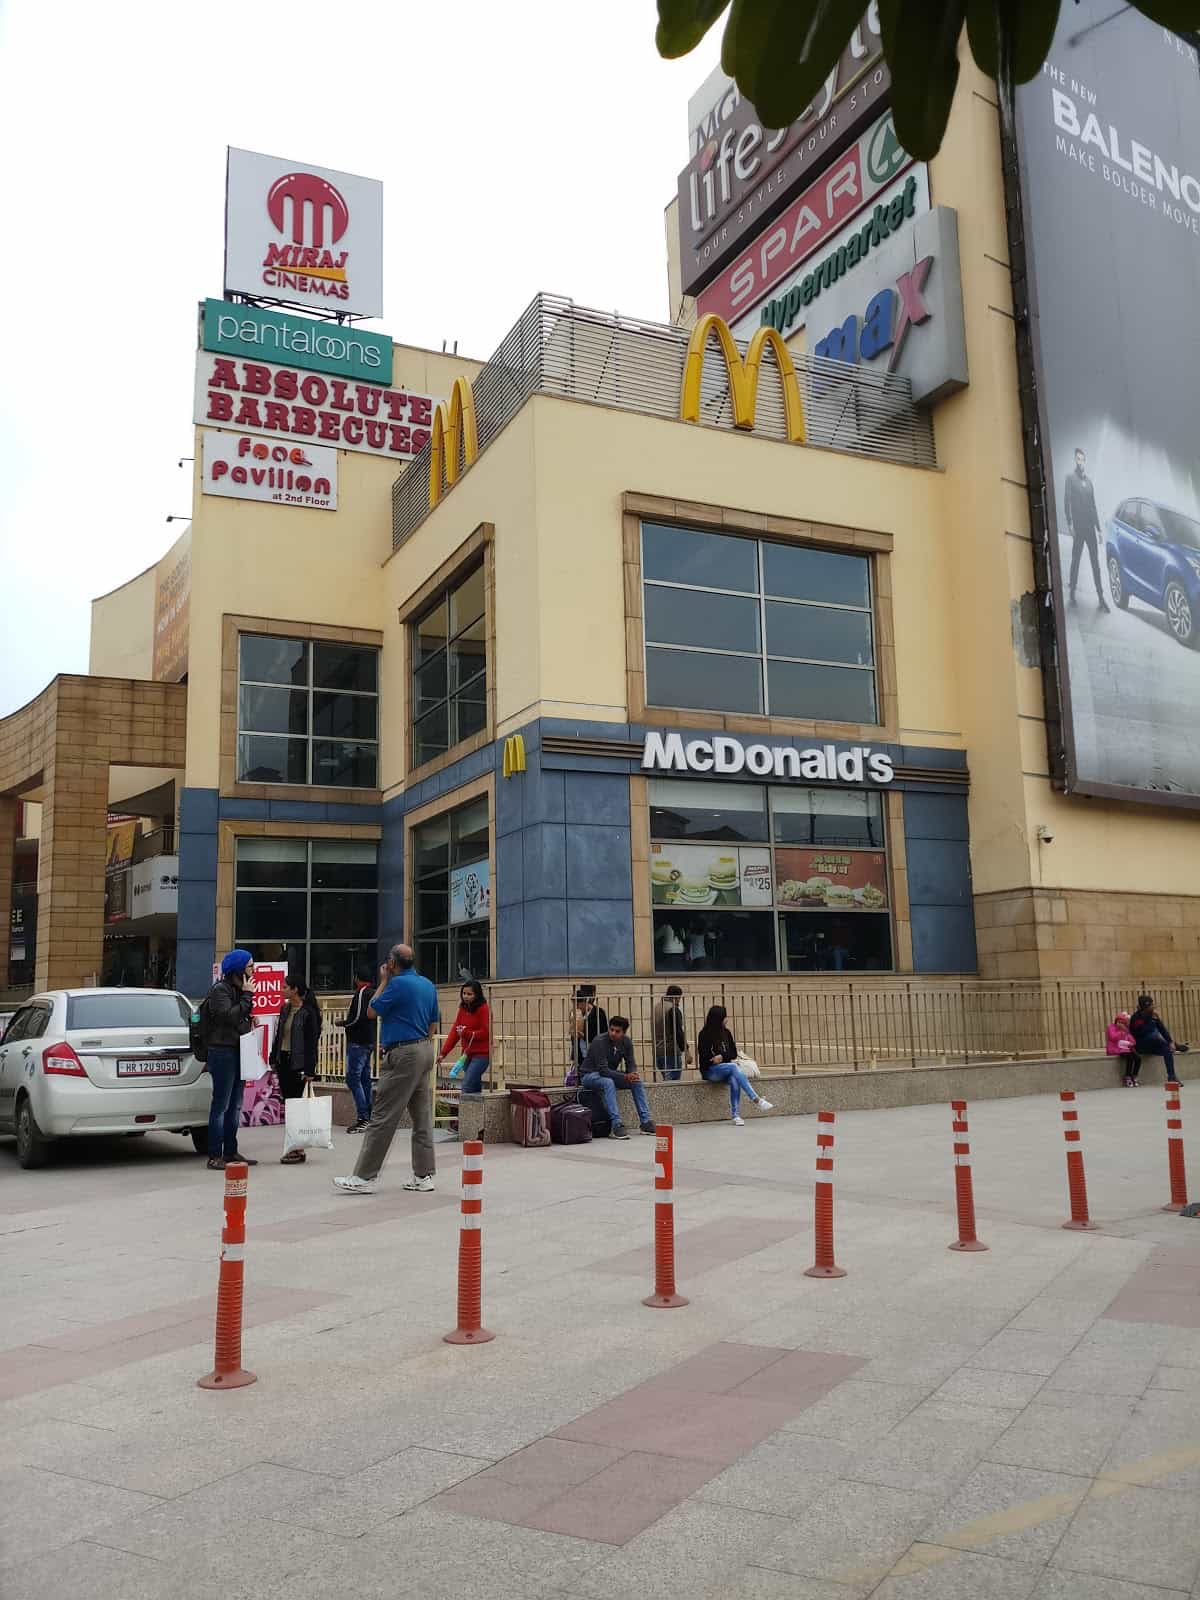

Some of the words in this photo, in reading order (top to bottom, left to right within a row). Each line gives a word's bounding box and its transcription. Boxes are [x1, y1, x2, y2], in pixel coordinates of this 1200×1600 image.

[1071, 79, 1097, 105] NEW
[695, 229, 728, 266] YOUR
[737, 168, 785, 225] STYLE
[798, 114, 838, 162] YOUR
[1055, 135, 1096, 173] MAKE
[1103, 167, 1156, 209] BOLDER
[263, 242, 349, 269] MIRAJ
[729, 160, 858, 307] SPAR
[760, 175, 916, 333] Hypermarket
[262, 269, 350, 300] CINEMAS
[217, 313, 382, 368] pantaloons
[813, 255, 935, 380] max
[207, 357, 433, 427] ABSOLUTE
[206, 391, 432, 455] BARBECUES
[272, 493, 282, 501] at
[285, 493, 303, 503] 2nd
[305, 496, 331, 506] Floor
[640, 731, 895, 784] McDonald's
[126, 1063, 137, 1073] HR
